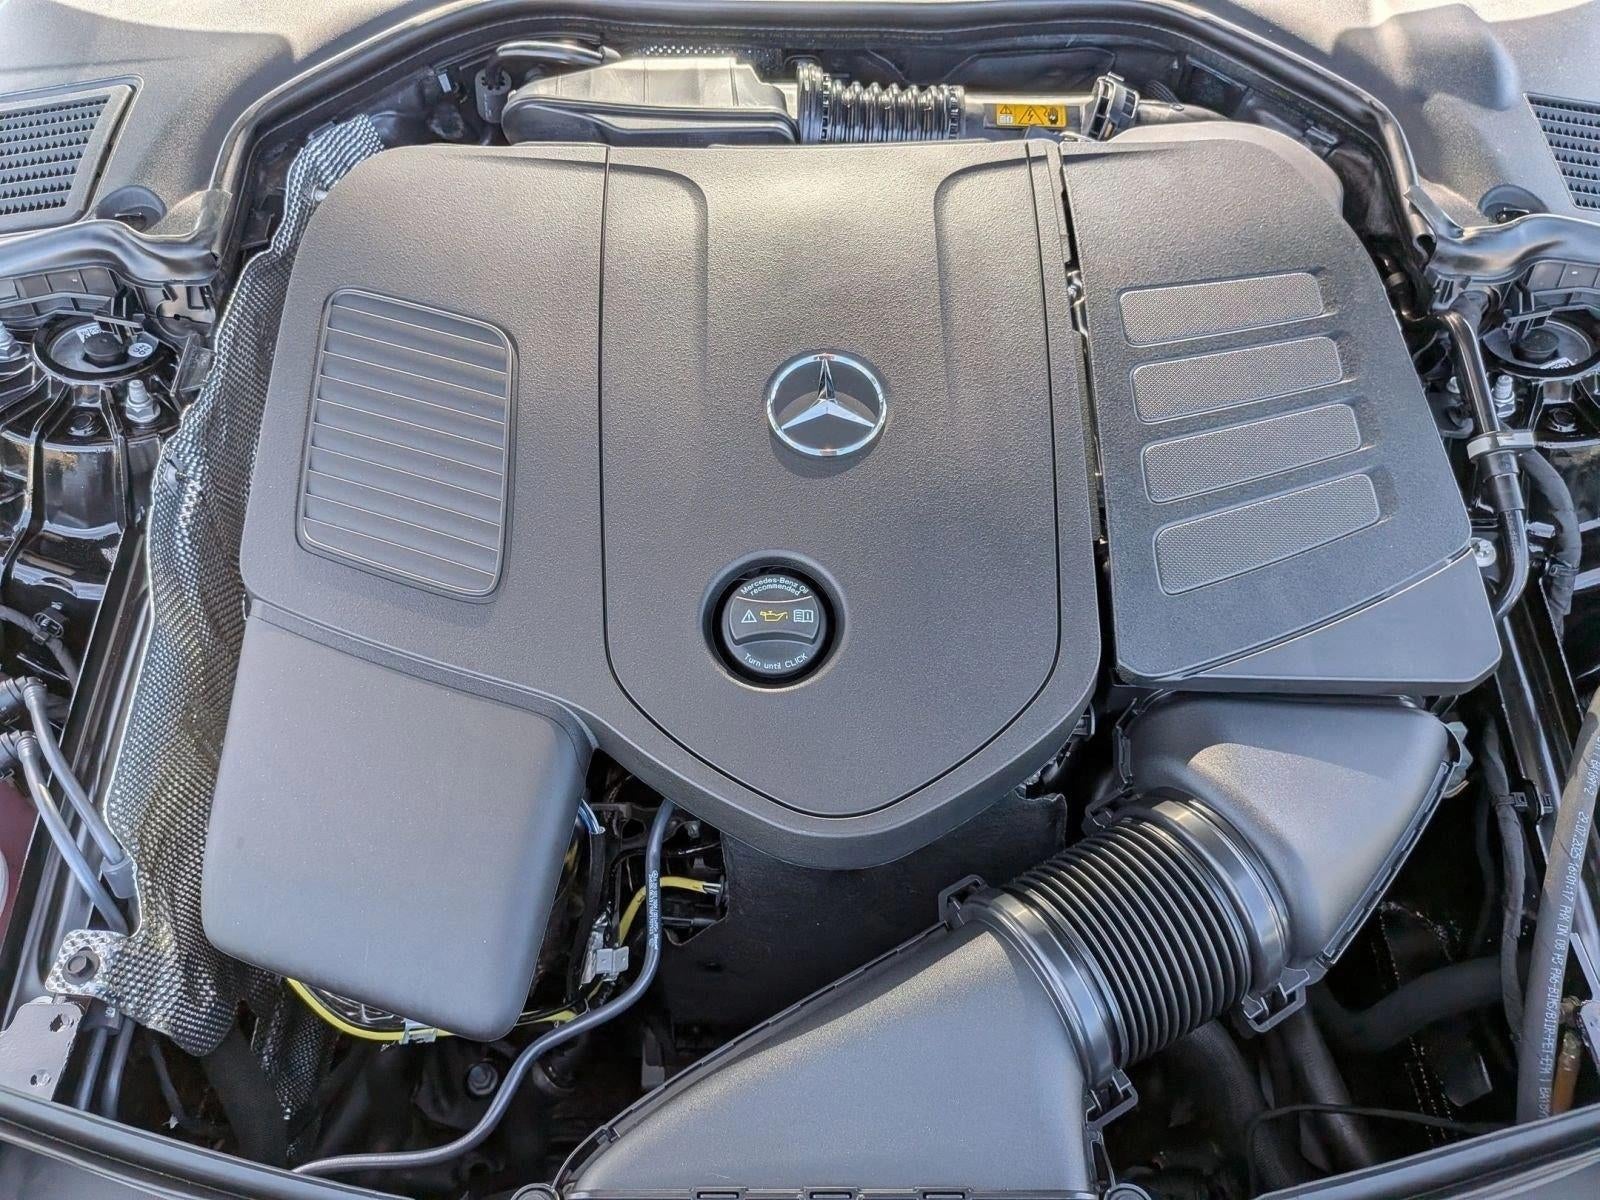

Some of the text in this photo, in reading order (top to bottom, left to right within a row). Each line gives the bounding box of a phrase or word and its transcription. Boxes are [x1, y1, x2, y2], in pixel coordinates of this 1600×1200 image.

[740, 577, 809, 595] Mercedes-Benz Oil
[750, 583, 801, 596] recommended
[744, 652, 808, 670] Turn until CLICK
[1570, 811, 1589, 860] 29.07.2025
